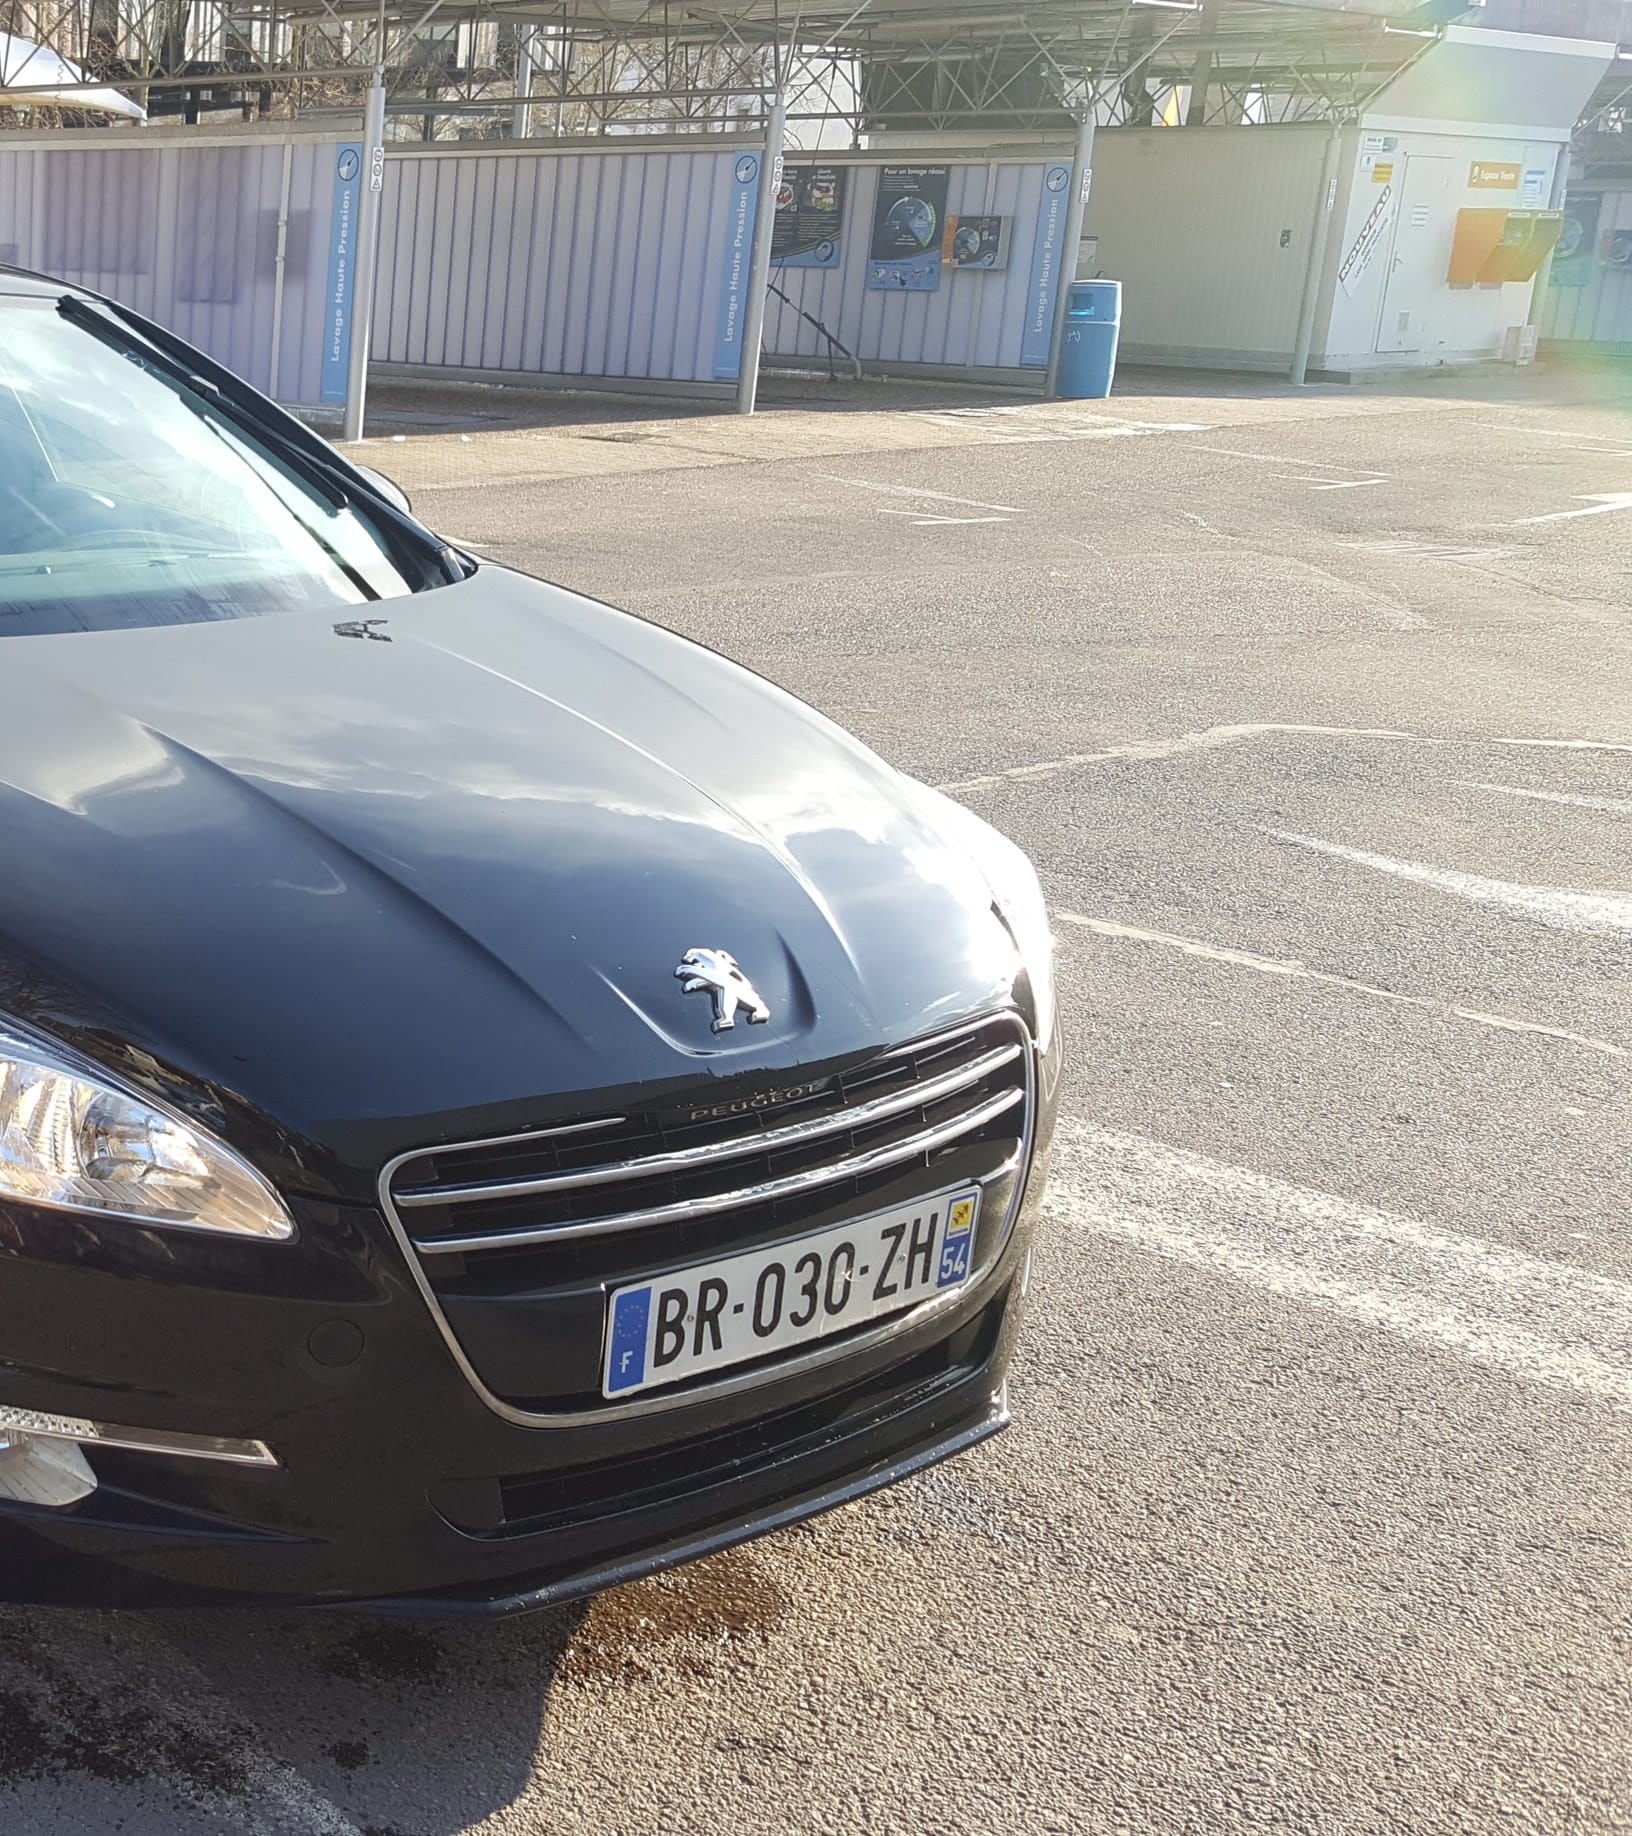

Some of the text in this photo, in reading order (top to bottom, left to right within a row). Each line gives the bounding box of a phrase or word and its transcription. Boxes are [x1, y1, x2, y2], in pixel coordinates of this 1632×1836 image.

[331, 190, 350, 361] Lavage Haute Pression
[724, 191, 747, 342] Lavage Haute Pression
[1034, 199, 1058, 333] Lavage Haute Pression
[1340, 188, 1391, 280] NOUVEAU
[690, 1084, 819, 1120] PEUGEOT
[618, 1212, 968, 1374] F BR-030-ZH 54
